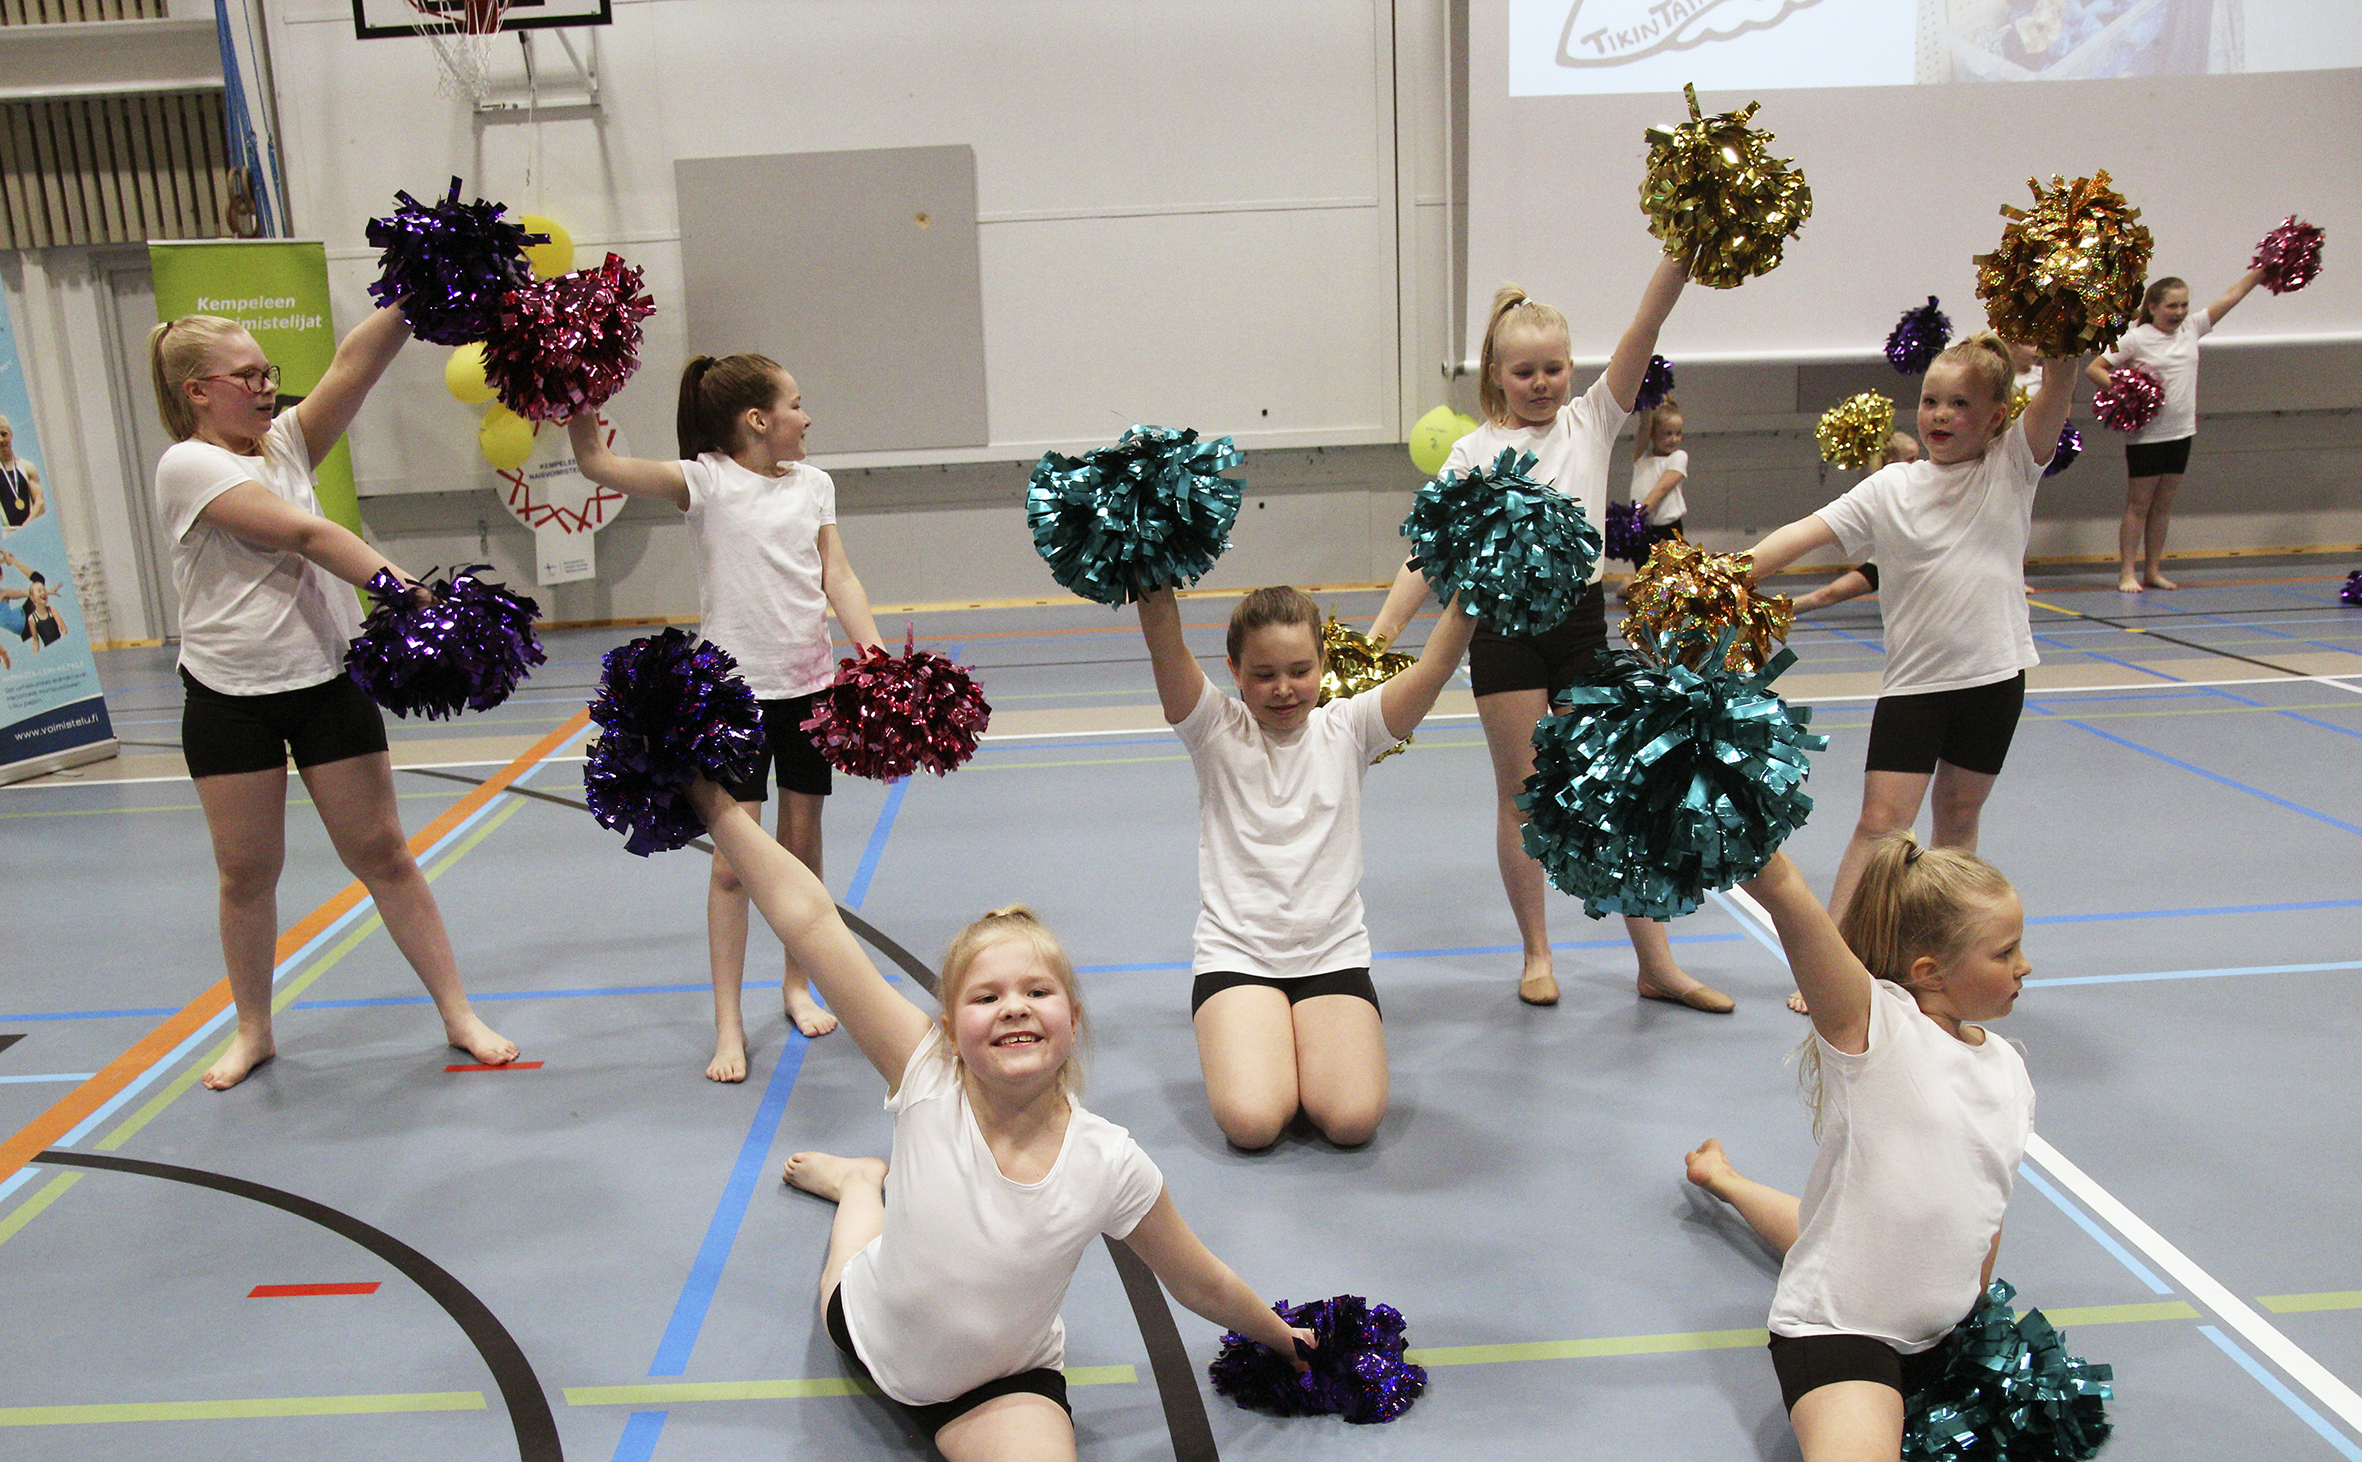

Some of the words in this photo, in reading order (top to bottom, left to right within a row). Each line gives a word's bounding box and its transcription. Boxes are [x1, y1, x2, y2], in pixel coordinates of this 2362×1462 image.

[197, 295, 296, 312] Kempeleen
[236, 315, 323, 331] imistelijat
[540, 459, 576, 469] KEMPELEE
[529, 468, 579, 479] NAISVOIMISTEL
[15, 714, 99, 741] www.voimistelu.fi
